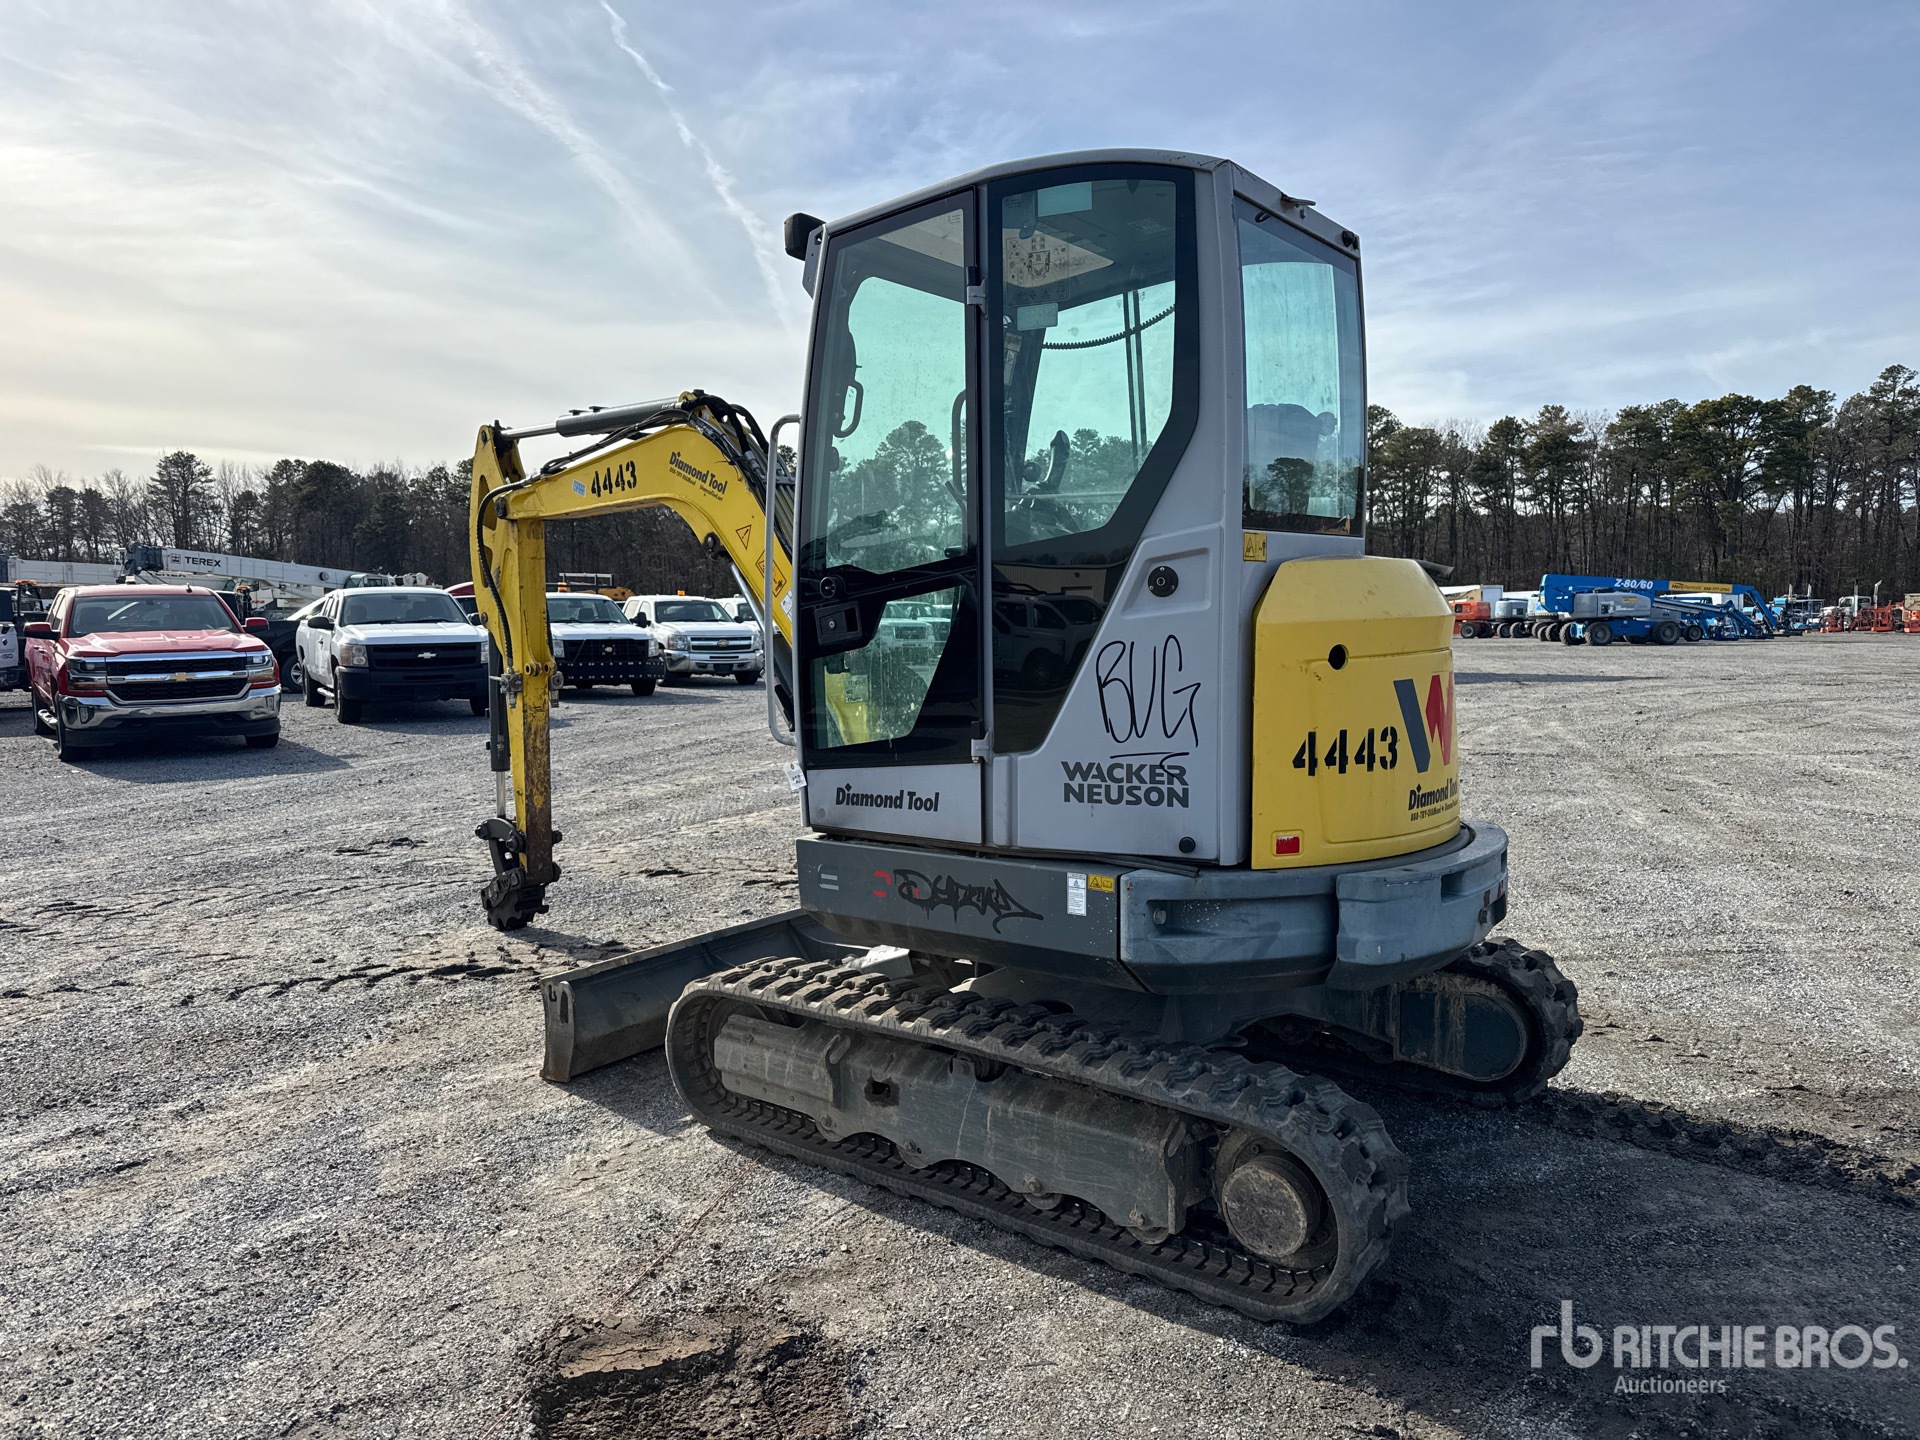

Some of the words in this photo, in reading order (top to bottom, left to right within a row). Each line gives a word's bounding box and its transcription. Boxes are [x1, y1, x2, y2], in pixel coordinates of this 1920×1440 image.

[591, 460, 637, 497] 4443
[669, 451, 710, 484] Diamond
[709, 472, 728, 494] Tool
[185, 556, 221, 567] TEREX
[1614, 578, 1654, 590] Z-80/60
[1096, 634, 1201, 748] BUG
[1292, 726, 1398, 776] 4443
[1061, 761, 1189, 786] WACKER
[836, 783, 904, 809] Diamond
[907, 791, 940, 812] Tool
[1063, 783, 1189, 808] NEUSON
[1408, 778, 1449, 811] Diamond
